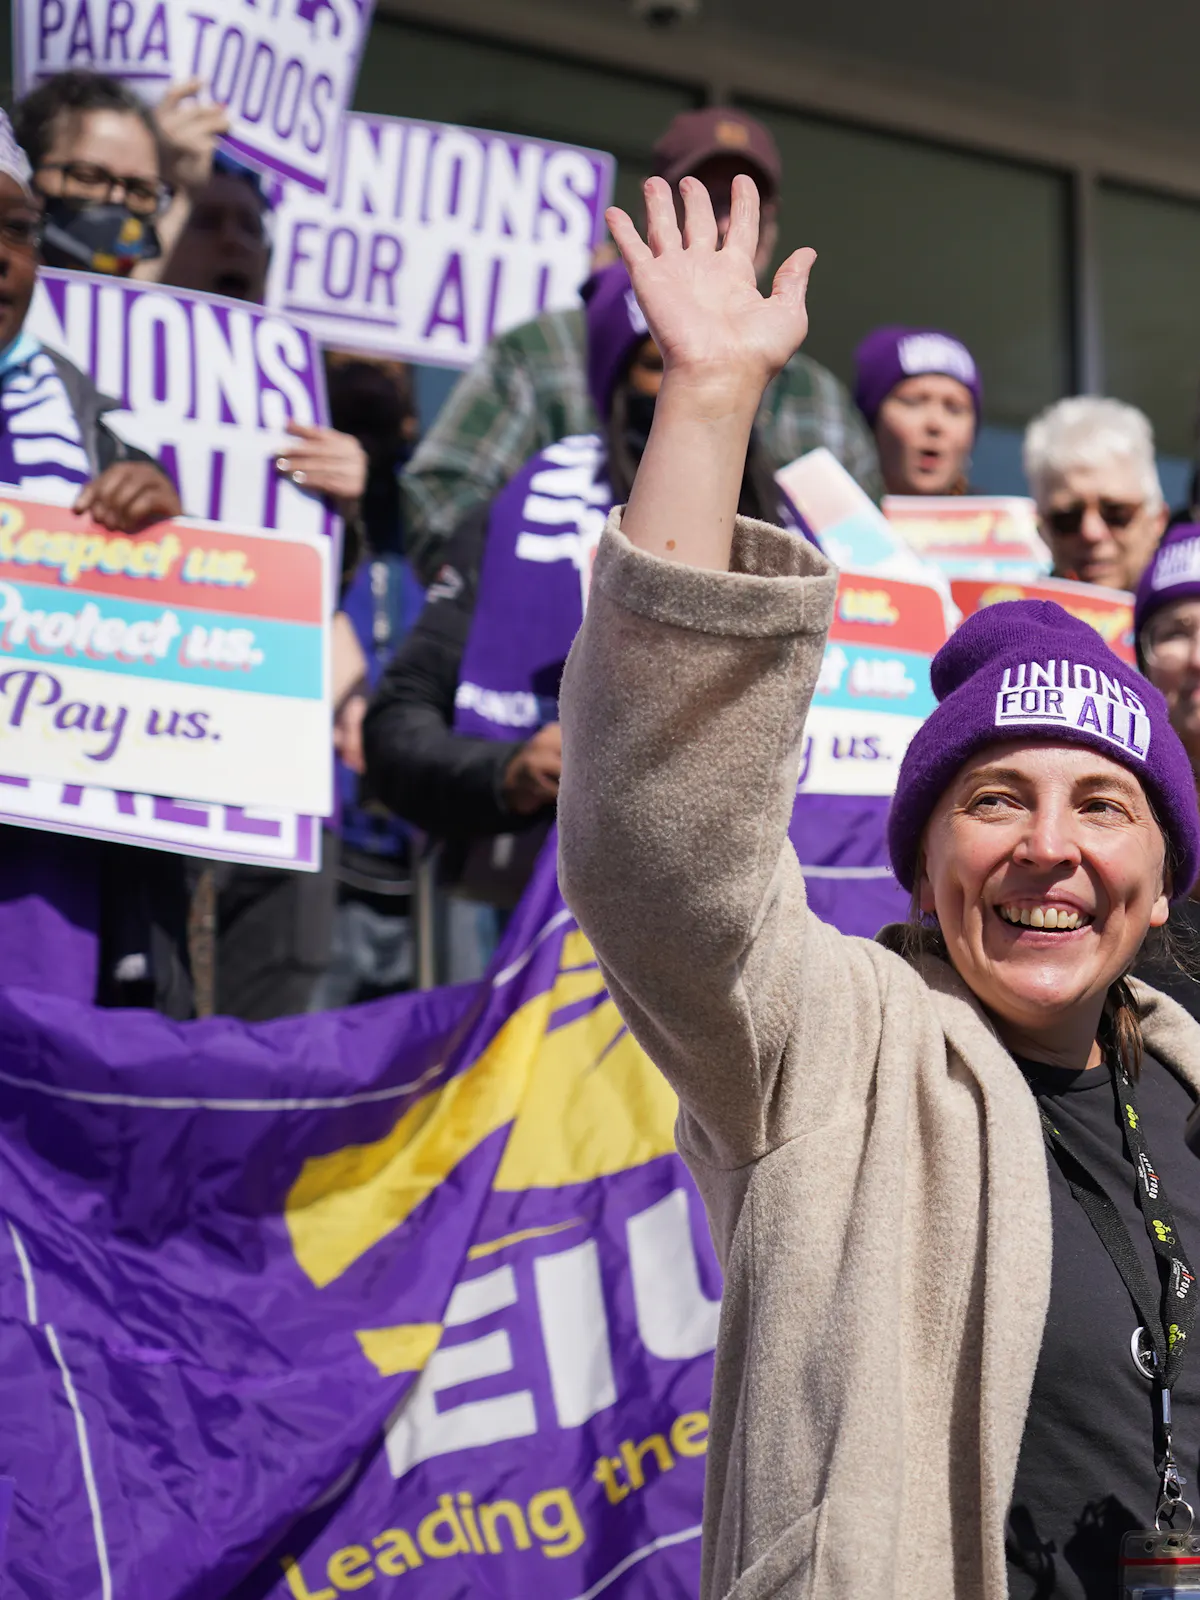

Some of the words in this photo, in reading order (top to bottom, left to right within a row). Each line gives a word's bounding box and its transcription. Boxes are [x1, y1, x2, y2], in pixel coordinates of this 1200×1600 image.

[38, 0, 170, 62] PARA
[188, 12, 332, 154] TODOS
[325, 117, 598, 244] NIONS
[285, 220, 403, 307] FOR
[28, 272, 318, 434] NIONS
[183, 545, 257, 588] us.
[180, 622, 265, 670] us.
[1001, 659, 1147, 716] UNIONS
[0, 668, 129, 762] Pay
[145, 708, 221, 742] us.
[832, 736, 892, 760] us.
[1001, 689, 1064, 714] FOR
[1076, 695, 1144, 756] ALL
[281, 1487, 585, 1600] Leading
[593, 1410, 709, 1505] the
